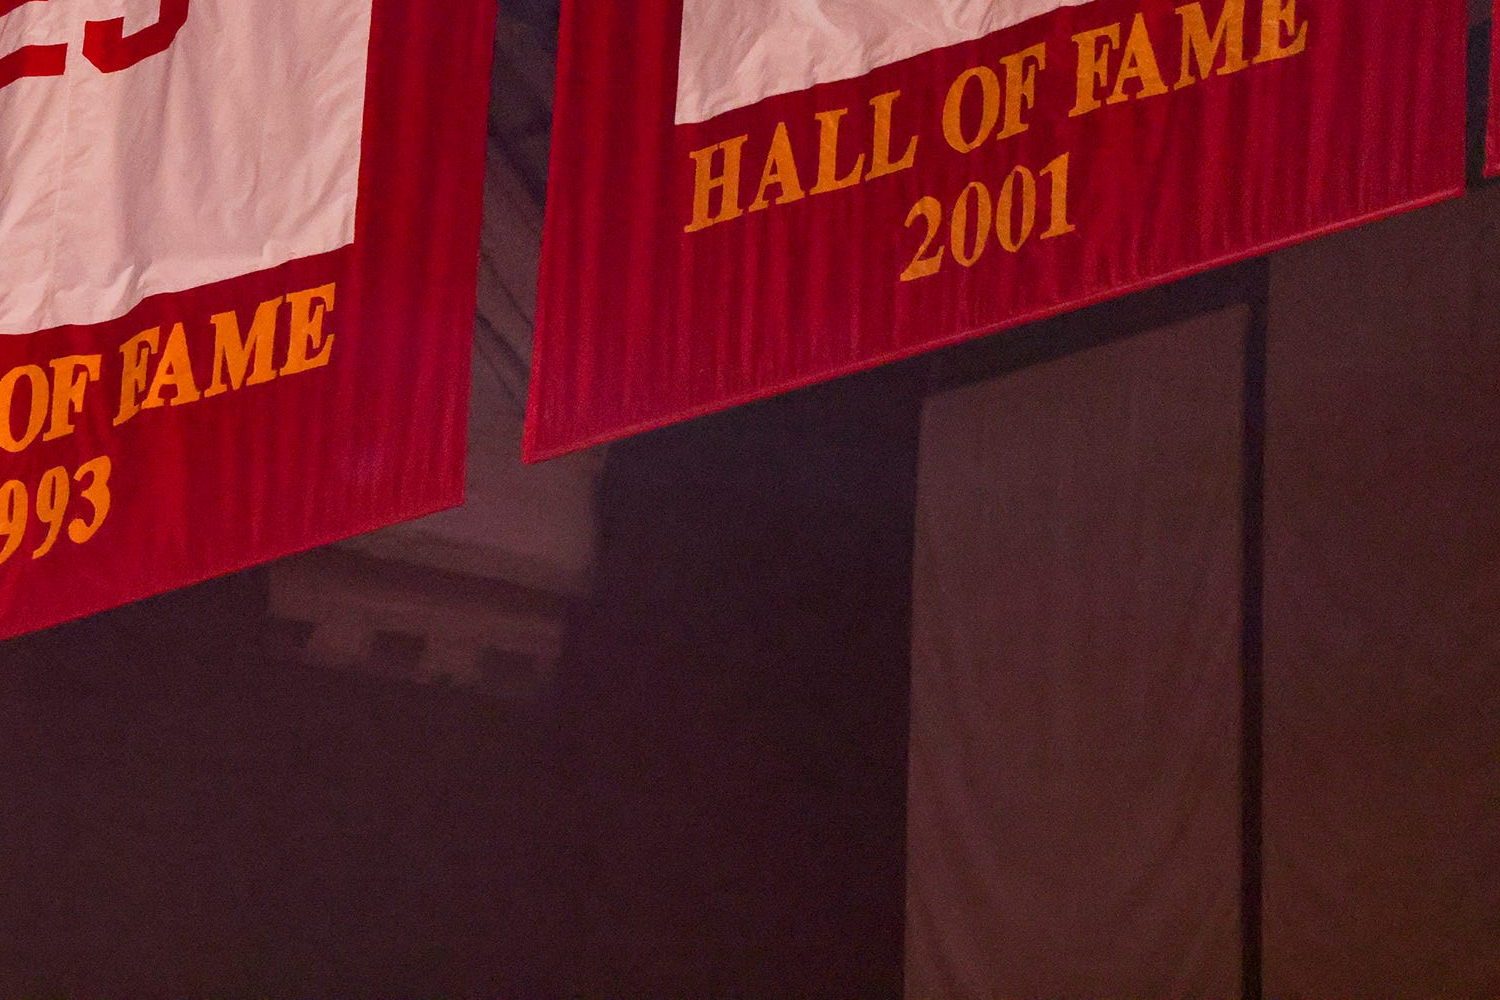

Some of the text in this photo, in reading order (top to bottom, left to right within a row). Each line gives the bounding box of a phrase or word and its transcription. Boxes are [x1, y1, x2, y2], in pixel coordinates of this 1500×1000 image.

[683, 90, 919, 233] HALL
[941, 42, 1046, 154] OF
[900, 151, 1076, 283] 2001
[113, 282, 337, 427] FAME
